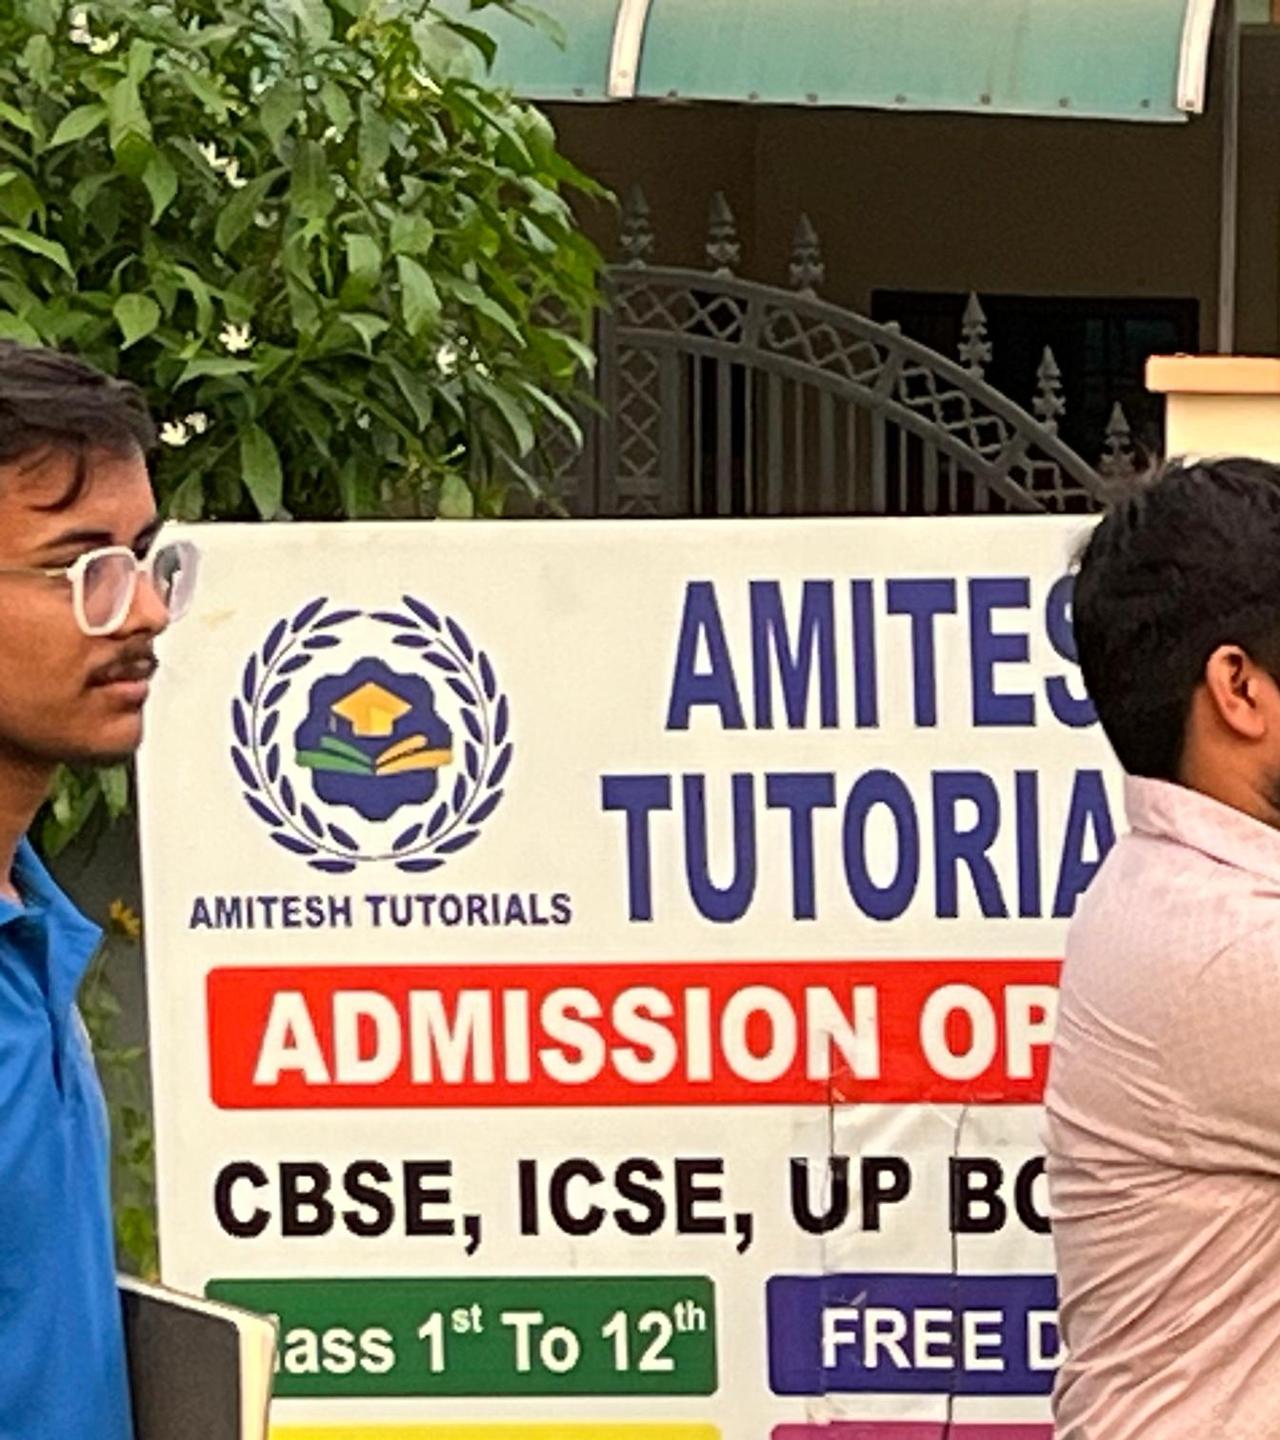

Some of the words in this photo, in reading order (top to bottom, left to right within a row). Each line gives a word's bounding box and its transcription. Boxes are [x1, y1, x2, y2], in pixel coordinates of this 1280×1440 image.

[665, 575, 1099, 729] AMITES
[601, 770, 1116, 923] TUTORIA
[189, 896, 352, 929] AMITESH
[365, 893, 573, 928] TUTORIALS
[253, 984, 880, 1085] ADMISSION
[919, 984, 1061, 1080] OP
[214, 1159, 481, 1256] CBSE,
[518, 1157, 753, 1254] ICSE,
[790, 1156, 911, 1234] UP
[272, 1326, 395, 1373] ass
[417, 1303, 482, 1373] 1st
[501, 1310, 580, 1373] To
[602, 1300, 705, 1372] 12th
[822, 1306, 1004, 1370] FREE
